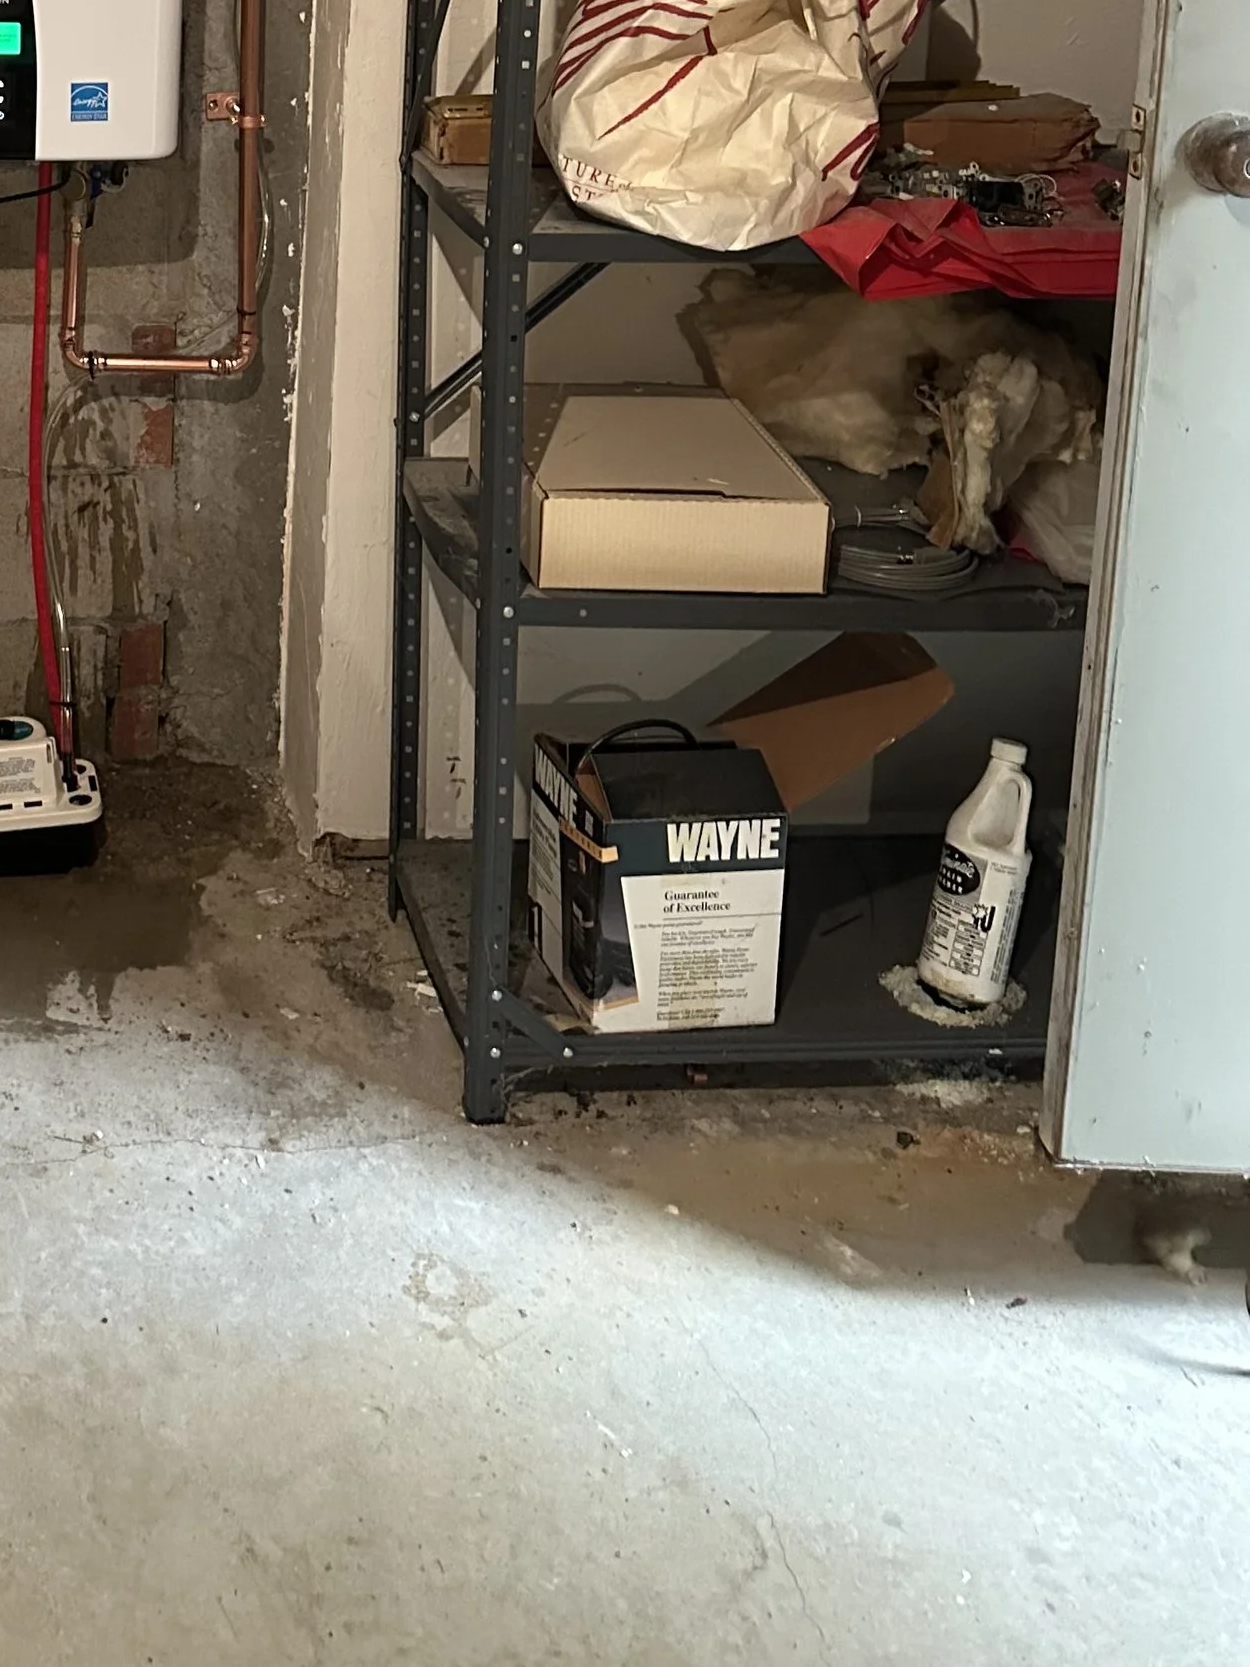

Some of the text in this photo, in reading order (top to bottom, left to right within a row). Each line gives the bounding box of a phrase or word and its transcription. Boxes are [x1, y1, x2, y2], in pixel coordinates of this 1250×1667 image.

[534, 743, 578, 830] WAYNE
[667, 818, 781, 863] WAYNE
[663, 900, 731, 913] of Excellence
[664, 890, 720, 901] Guarantee
